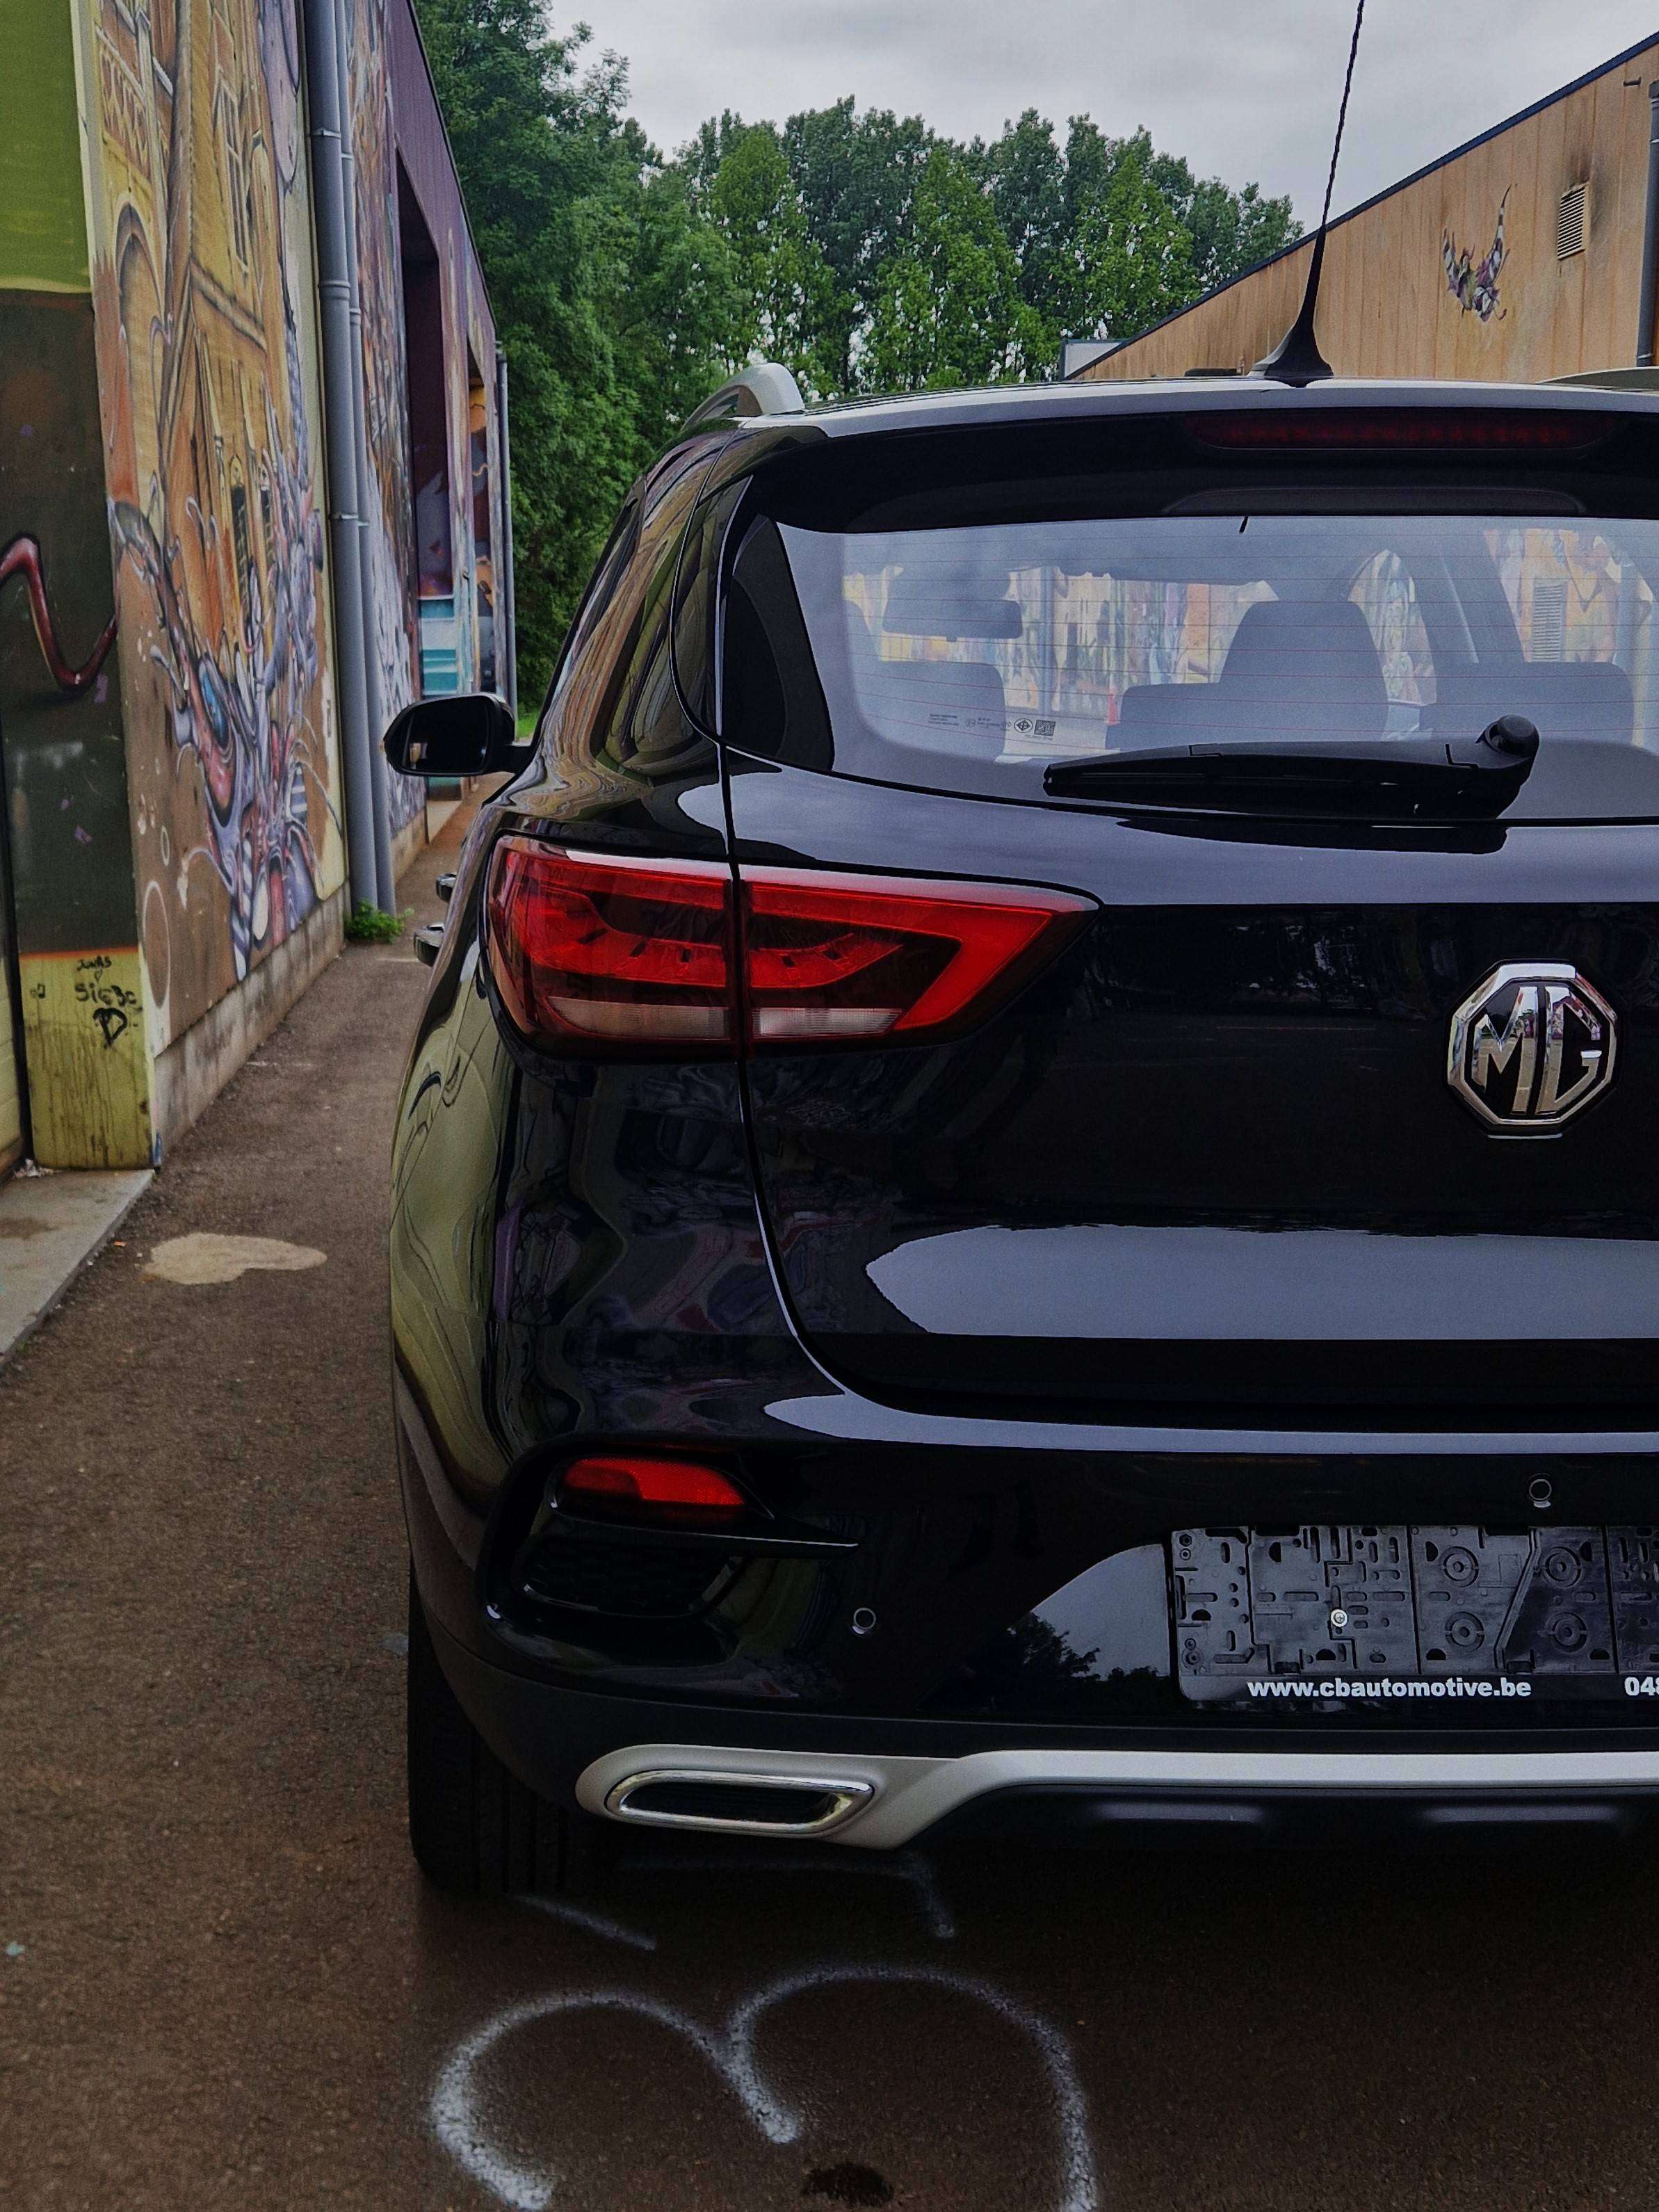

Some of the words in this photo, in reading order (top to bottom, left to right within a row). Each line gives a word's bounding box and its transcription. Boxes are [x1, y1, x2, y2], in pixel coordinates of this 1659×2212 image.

[1471, 985, 1603, 1116] MG
[1247, 1677, 1532, 1697] www.cbautomotive.be
[1624, 1676, 1659, 1696] 04
